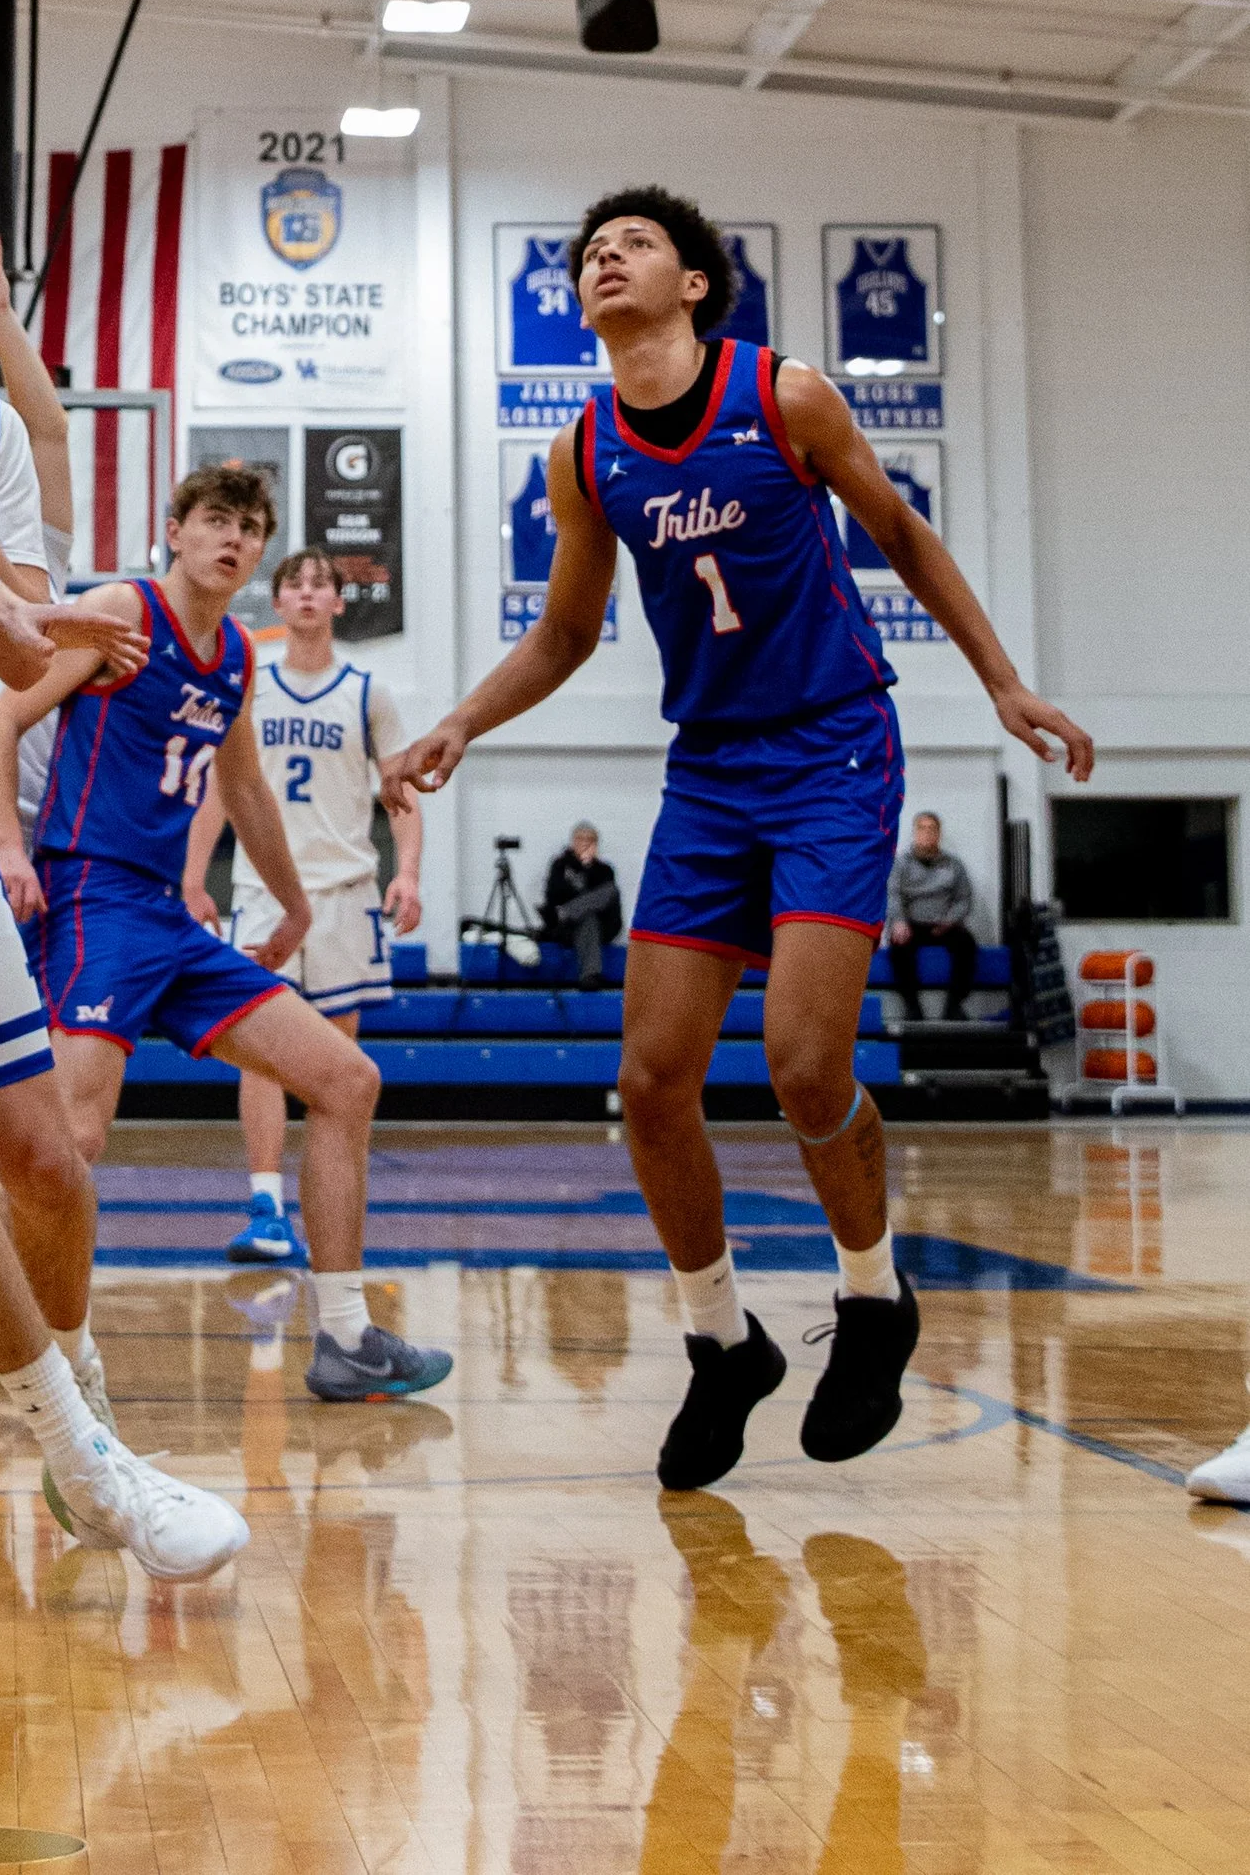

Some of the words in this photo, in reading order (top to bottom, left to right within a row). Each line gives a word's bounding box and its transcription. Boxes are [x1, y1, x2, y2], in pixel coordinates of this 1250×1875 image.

[258, 131, 345, 163] 2021
[305, 282, 383, 308] STATE
[537, 287, 569, 316] 34
[865, 289, 898, 317] 45
[232, 311, 371, 337] CHAMPION
[519, 381, 591, 404] JARED
[853, 383, 917, 404] ROSS
[335, 444, 369, 481] G
[643, 486, 747, 550] Tribe
[694, 552, 743, 636] 1
[169, 683, 226, 734] Tribe
[261, 716, 345, 750] BIRDS
[286, 754, 313, 803] 2
[76, 1005, 109, 1023] M
